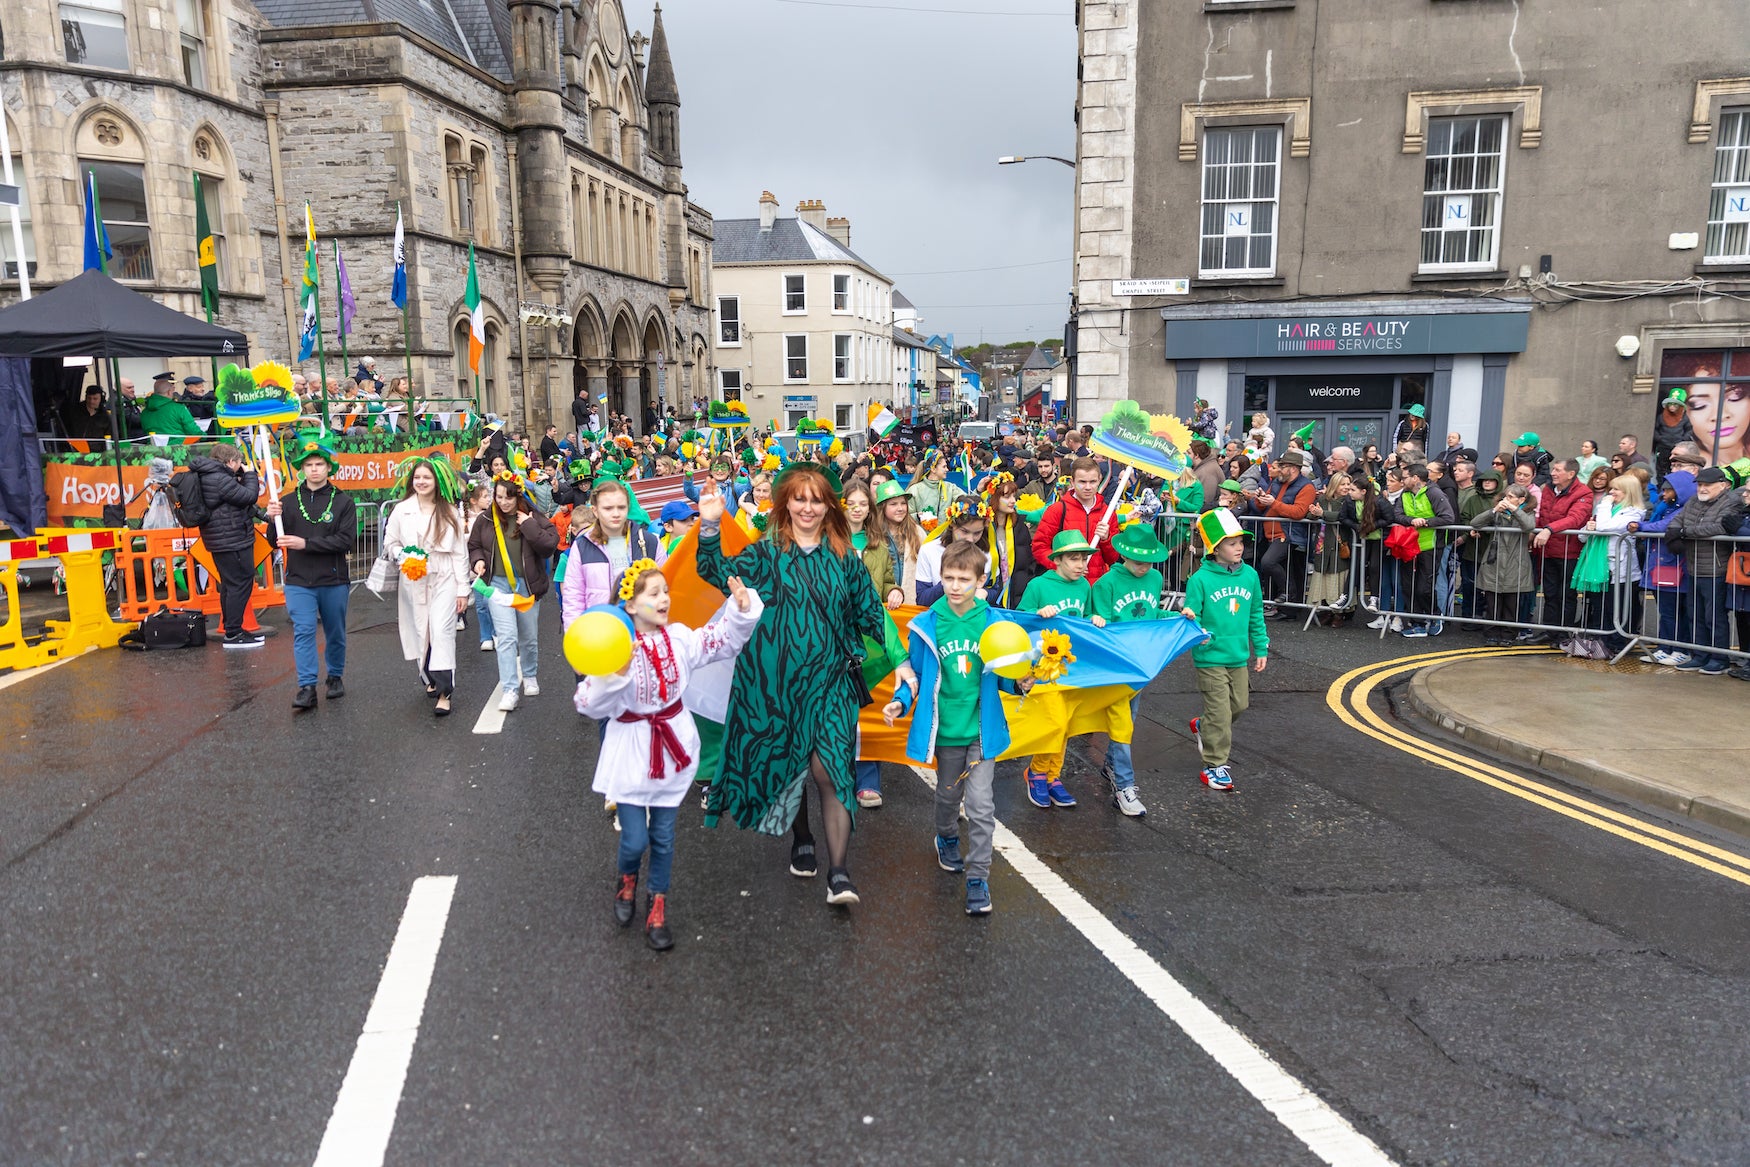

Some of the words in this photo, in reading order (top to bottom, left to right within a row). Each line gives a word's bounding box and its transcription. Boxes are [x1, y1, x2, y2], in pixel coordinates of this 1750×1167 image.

[1447, 204, 1467, 219] NL
[1728, 197, 1750, 212] NL
[1229, 212, 1248, 226] NL
[1277, 323, 1320, 338] HAIR
[1324, 322, 1338, 337] &
[1342, 321, 1410, 337] BEAUTY
[1337, 338, 1403, 351] SERVICES
[233, 390, 264, 403] Thanks
[264, 386, 282, 398] Sligo
[1309, 386, 1361, 397] welcome
[1116, 426, 1141, 443] Thank
[1140, 437, 1154, 446] you
[1152, 436, 1176, 457] Ireland
[367, 461, 385, 480] St.
[1113, 590, 1158, 613] IRELAND
[1210, 586, 1252, 603] IRELAND
[937, 638, 981, 660] IRELAN
